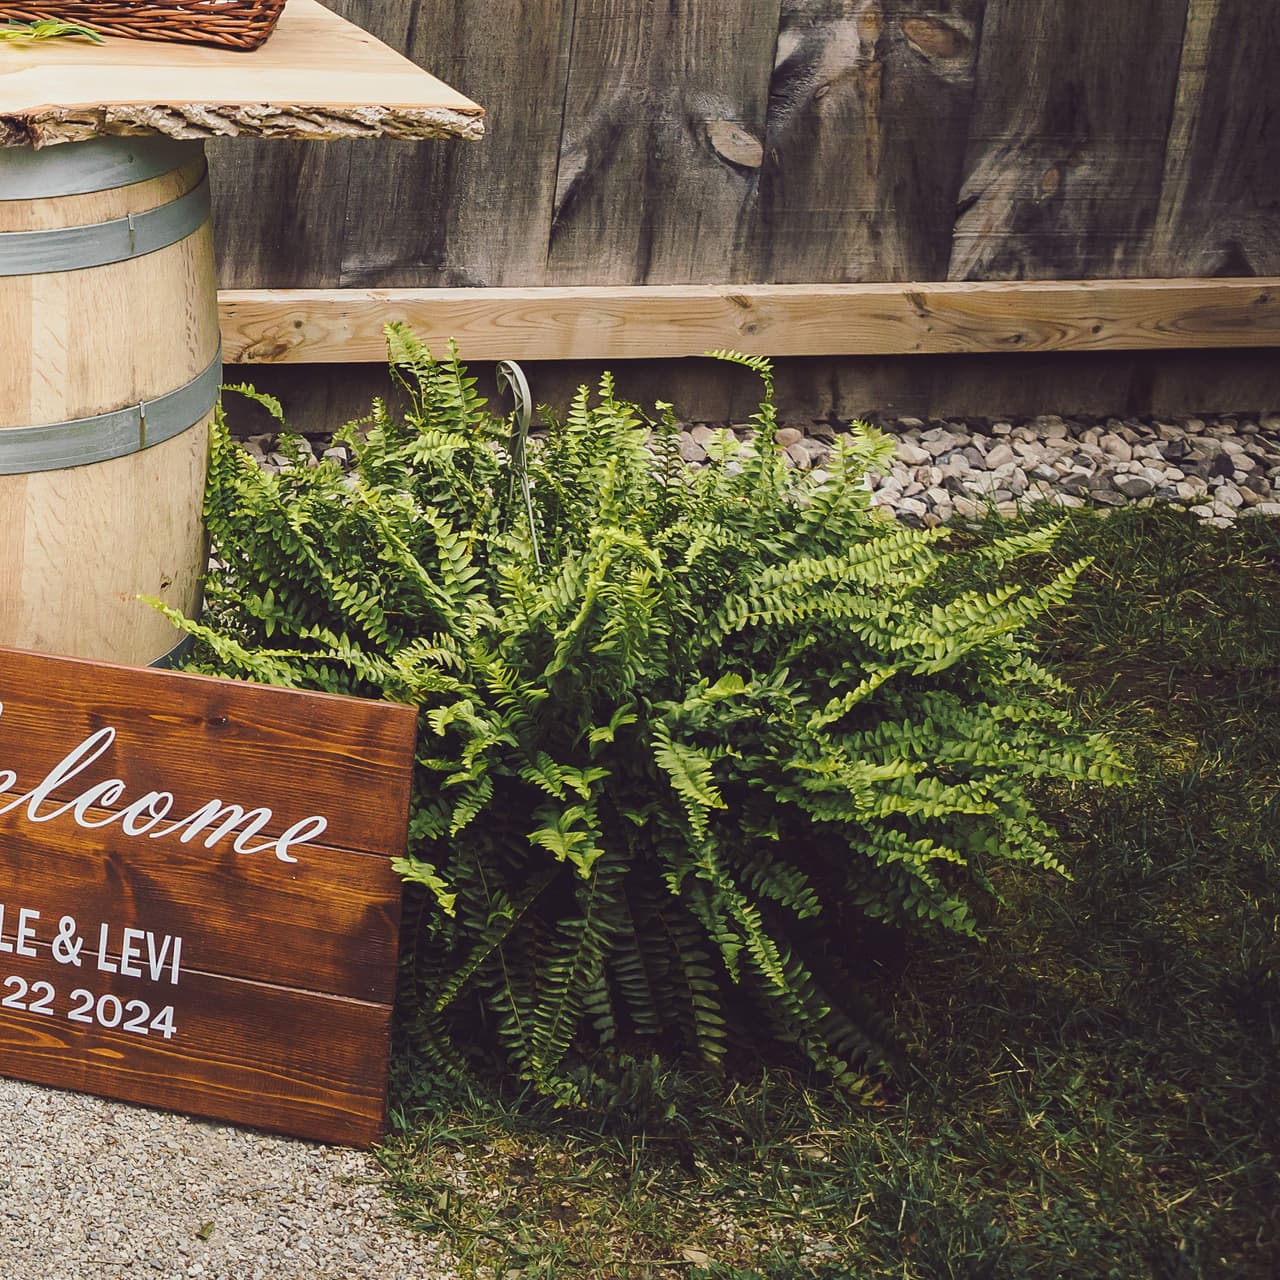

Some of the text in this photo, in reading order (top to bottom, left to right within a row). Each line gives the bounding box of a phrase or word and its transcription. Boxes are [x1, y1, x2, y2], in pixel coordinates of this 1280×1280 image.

[51, 914, 86, 965] &
[97, 922, 183, 985] LEVI
[1, 975, 55, 1016] 22
[67, 988, 177, 1039] 2024
